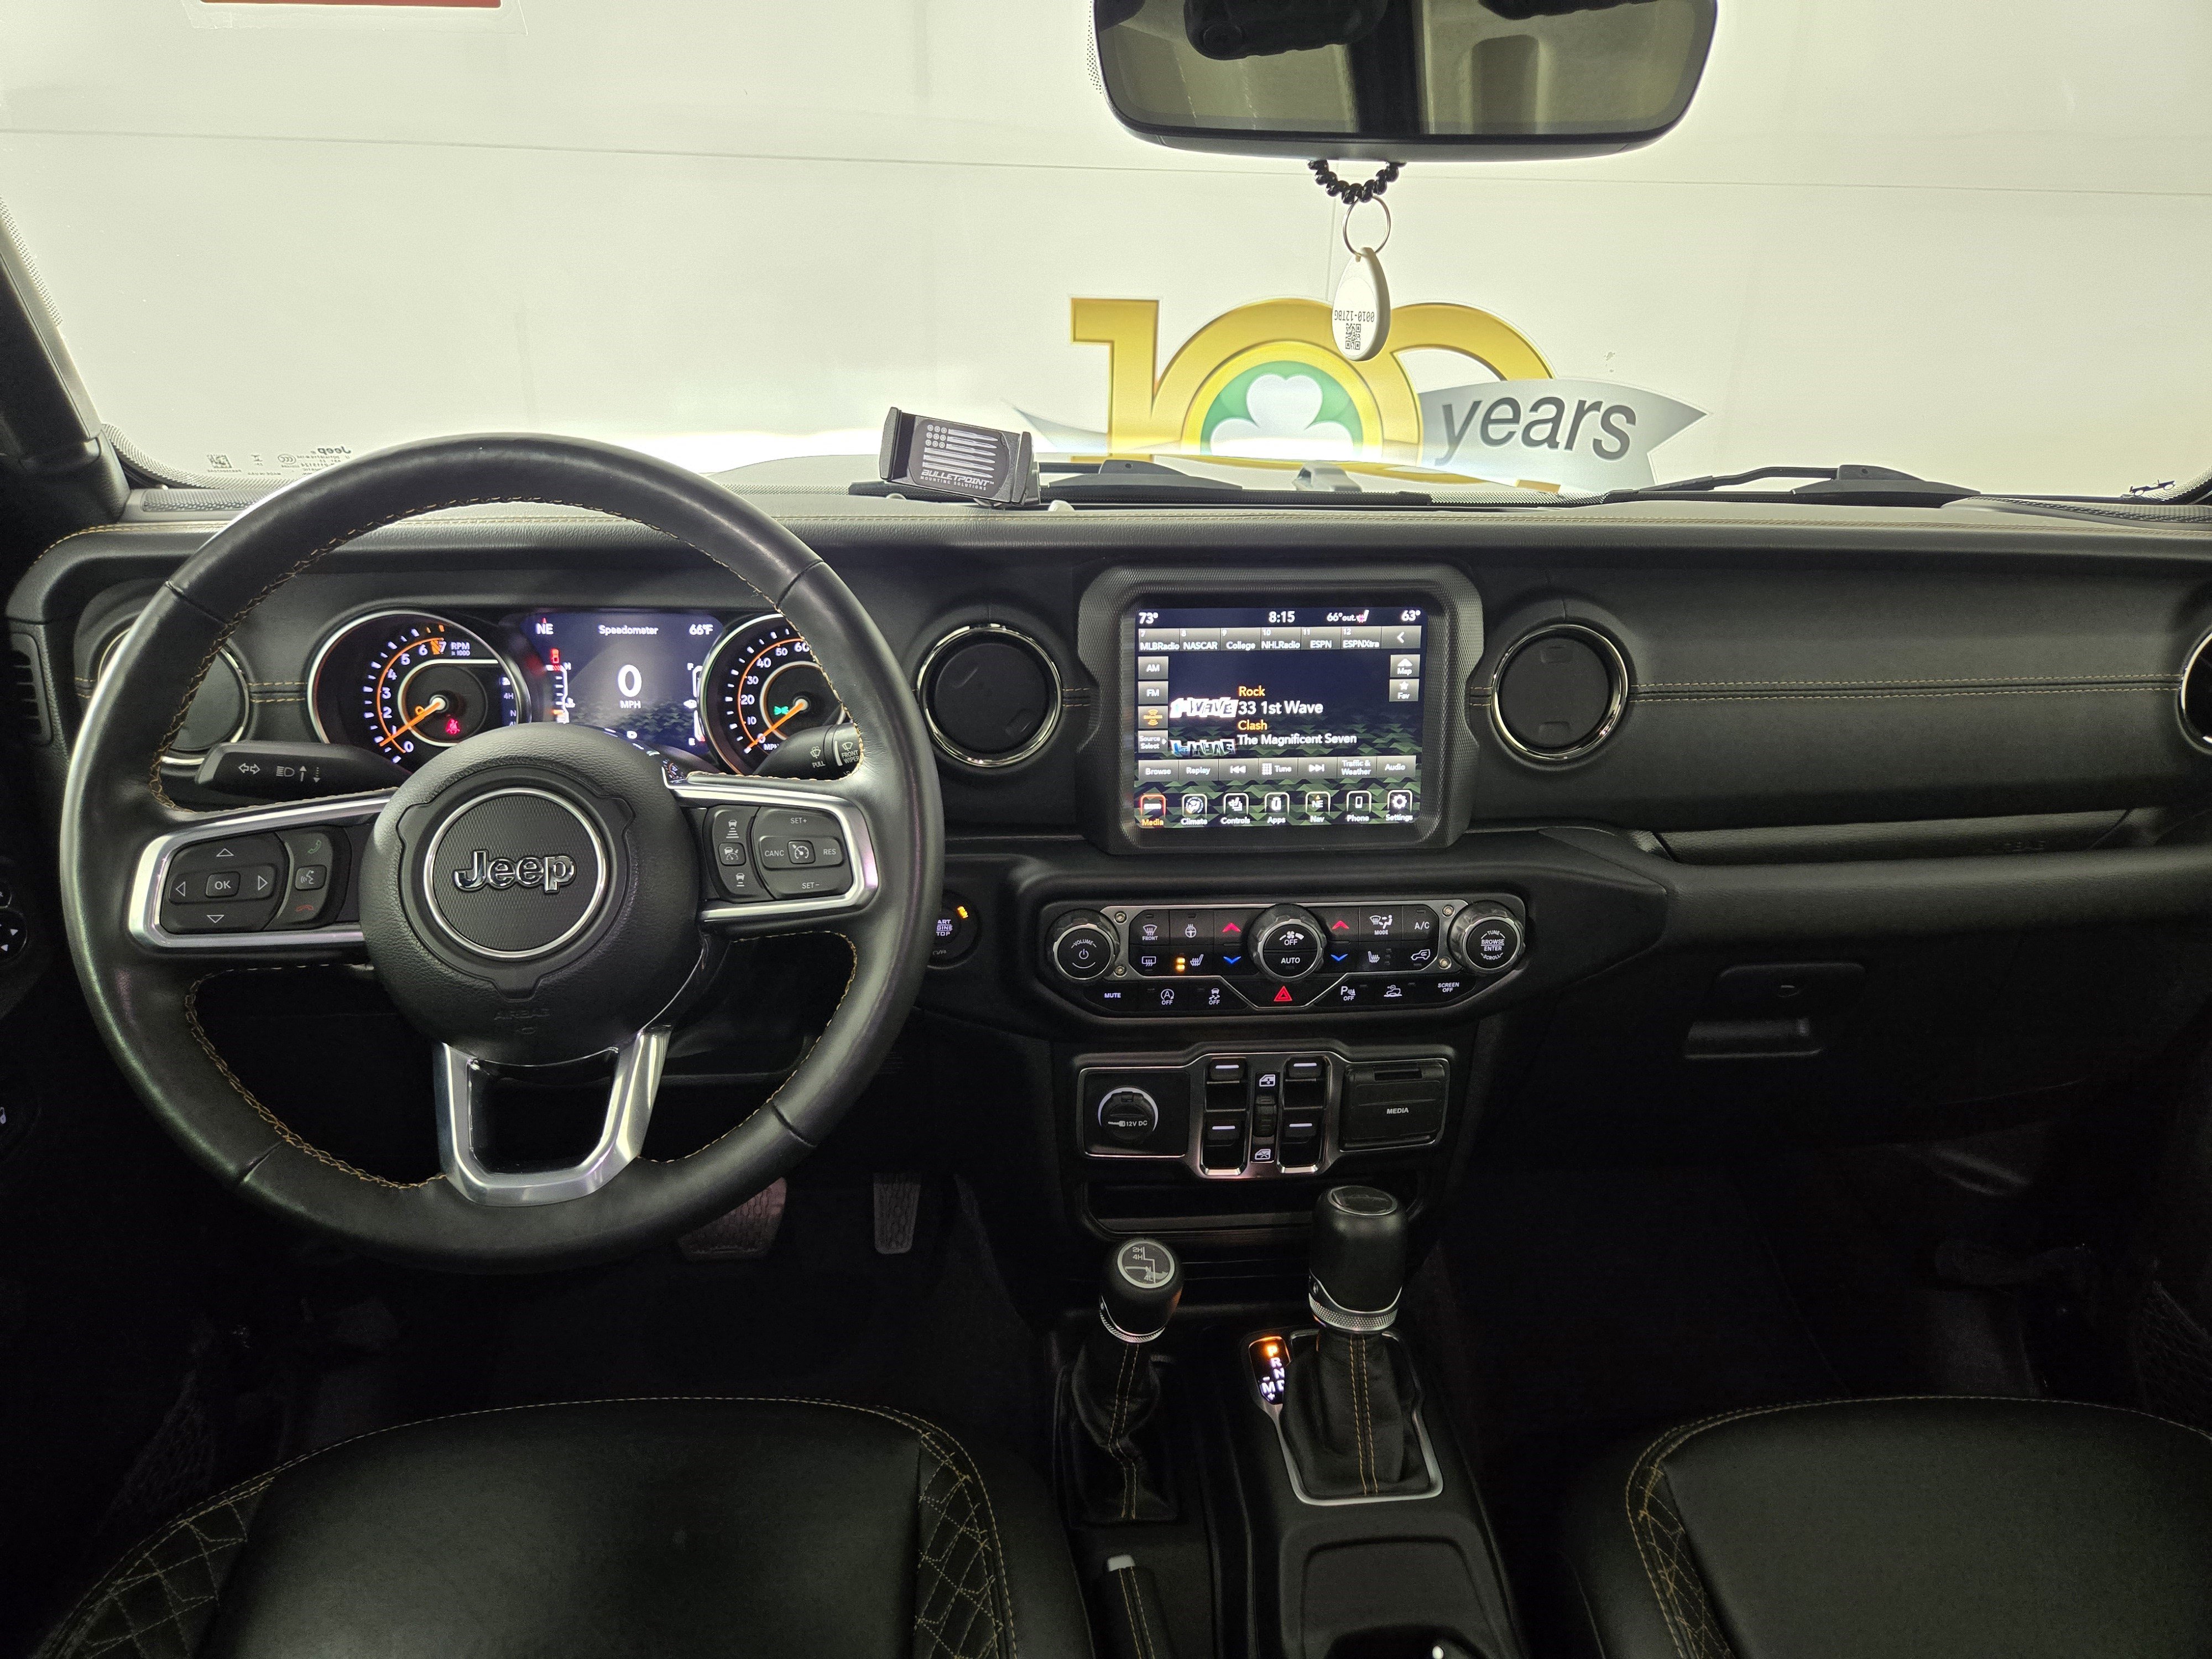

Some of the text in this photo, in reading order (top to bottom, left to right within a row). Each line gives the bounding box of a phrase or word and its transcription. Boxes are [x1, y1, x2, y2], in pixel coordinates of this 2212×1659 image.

[1334, 310, 1375, 323] 0010-12TBG
[1434, 396, 1637, 466] years
[953, 481, 987, 491] SOLUTIONS
[1268, 611, 1295, 623] 8:15
[1401, 609, 1421, 622] 63°
[535, 623, 554, 635] NE
[598, 625, 659, 636] Speedometer
[439, 641, 447, 654] 7
[451, 641, 471, 650] RPM
[1139, 641, 1180, 651] MLBRadio
[1183, 641, 1218, 650] NASCAR
[1226, 640, 1256, 651] College
[1261, 640, 1301, 650] NHLRadio
[1310, 640, 1332, 649] ESPN
[1343, 640, 1380, 649] ESPNXtra
[419, 644, 428, 656] 6
[775, 647, 789, 656] 50
[401, 654, 410, 665] 5
[757, 658, 771, 668] 40
[1146, 664, 1160, 672] AM
[1397, 667, 1412, 676] Map
[387, 669, 397, 681] 4
[618, 664, 642, 697] 0
[747, 676, 759, 685] 30
[382, 687, 392, 699] 3
[1146, 688, 1160, 697] FM
[1238, 685, 1265, 697] Rock
[619, 700, 641, 709] MPH
[741, 694, 755, 705] 20
[383, 706, 393, 718] 2
[1238, 700, 1324, 714] 33 1st Wave
[747, 716, 757, 725] 10
[1238, 719, 1267, 731] Clash
[1237, 733, 1357, 747] The Magnificent Seven
[404, 740, 414, 753] 0
[842, 750, 858, 758] FRONT
[812, 760, 826, 769] PULL
[843, 755, 860, 764] WIPER
[1342, 759, 1363, 768] Traffic
[1186, 766, 1211, 775] Replay
[1312, 800, 1323, 808] NE
[1385, 814, 1413, 822] Settings
[454, 850, 575, 893] Jeep
[214, 880, 232, 890] OK
[1414, 921, 1430, 930] A/C
[1073, 938, 1094, 947] VOLUME
[1267, 1345, 1278, 1357] P
[1271, 1357, 1282, 1368] R
[1273, 1368, 1285, 1379] N
[1261, 1381, 1276, 1394] M
